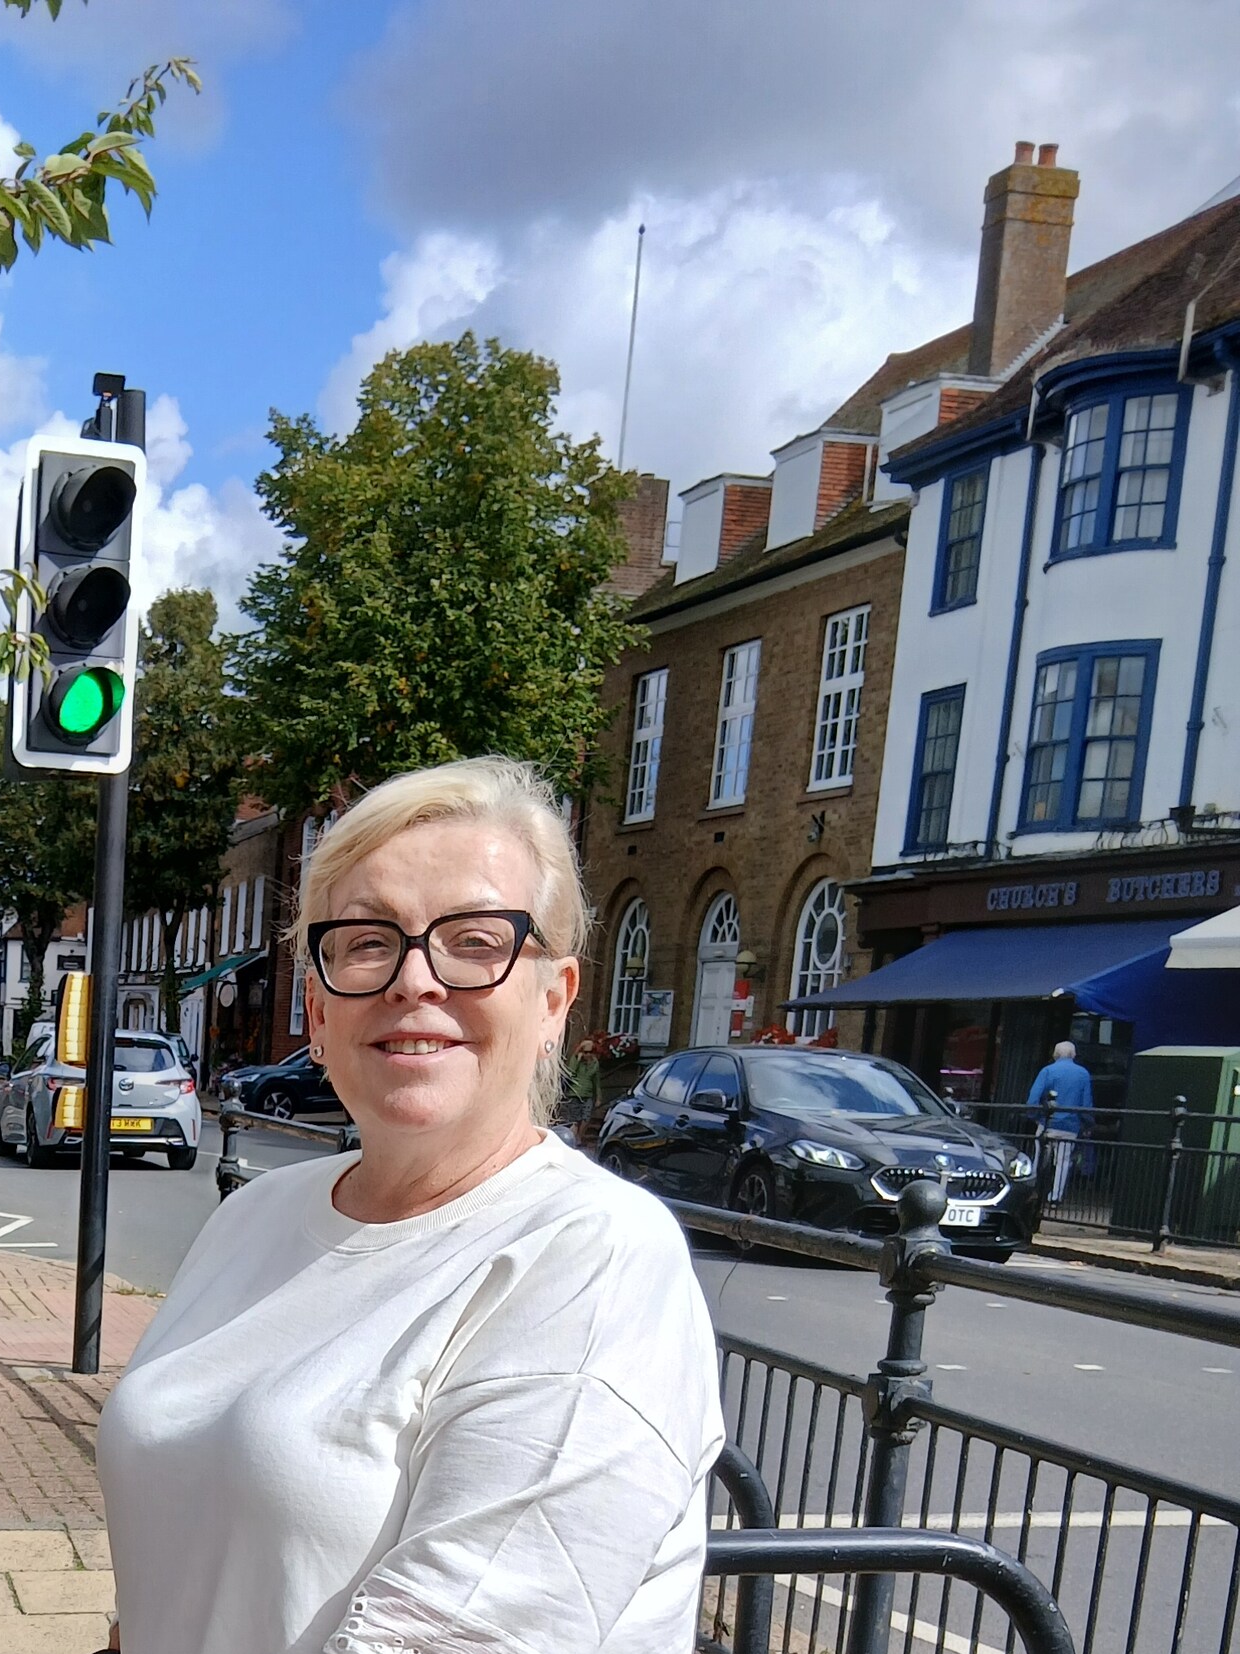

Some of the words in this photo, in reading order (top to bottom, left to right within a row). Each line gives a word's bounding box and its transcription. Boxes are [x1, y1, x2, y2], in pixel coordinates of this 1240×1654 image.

[986, 882, 1077, 911] CHURCH'S
[1106, 869, 1221, 902] BUTCHERS
[948, 1209, 974, 1223] OTC
